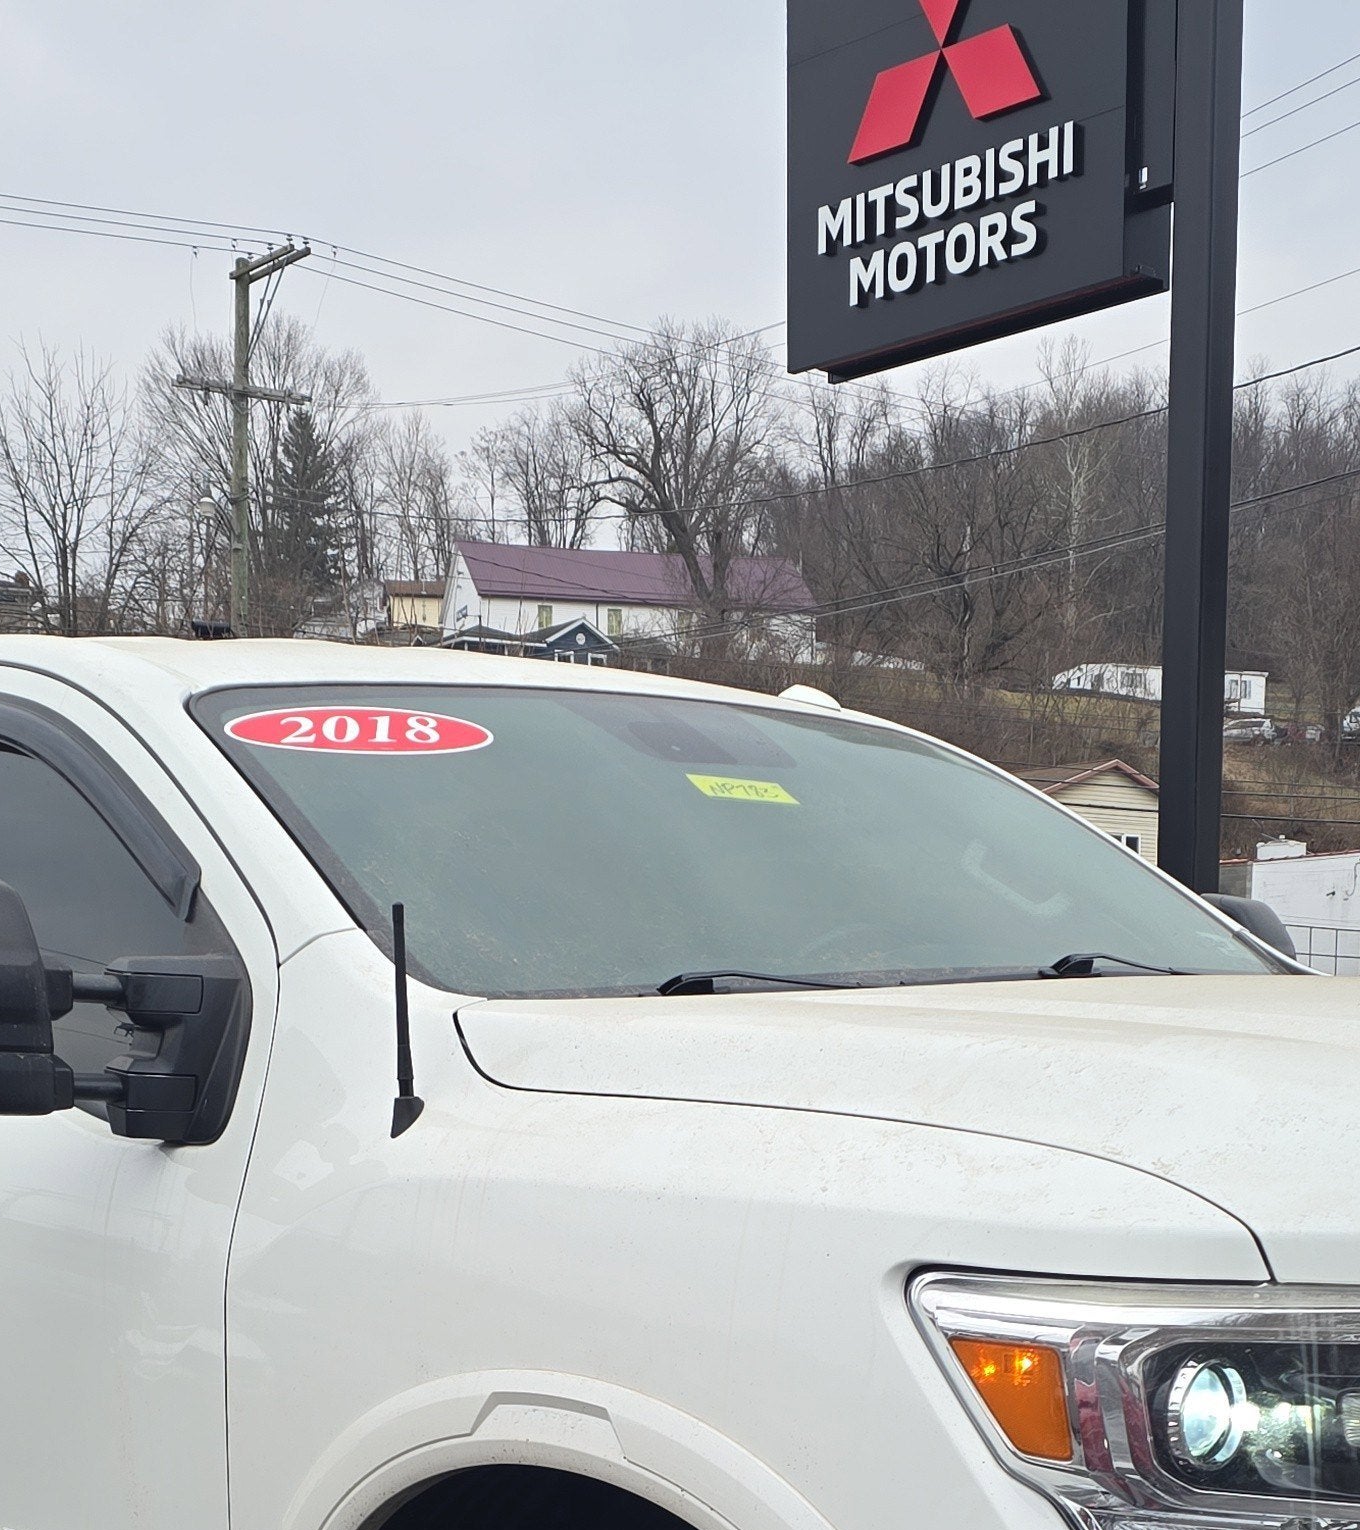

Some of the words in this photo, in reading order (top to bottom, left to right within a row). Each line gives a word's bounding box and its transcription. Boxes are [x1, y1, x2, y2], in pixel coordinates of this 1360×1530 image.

[817, 120, 1074, 255] MITSUBISHI
[848, 199, 1038, 307] MOTORS
[279, 715, 440, 744] 2018
